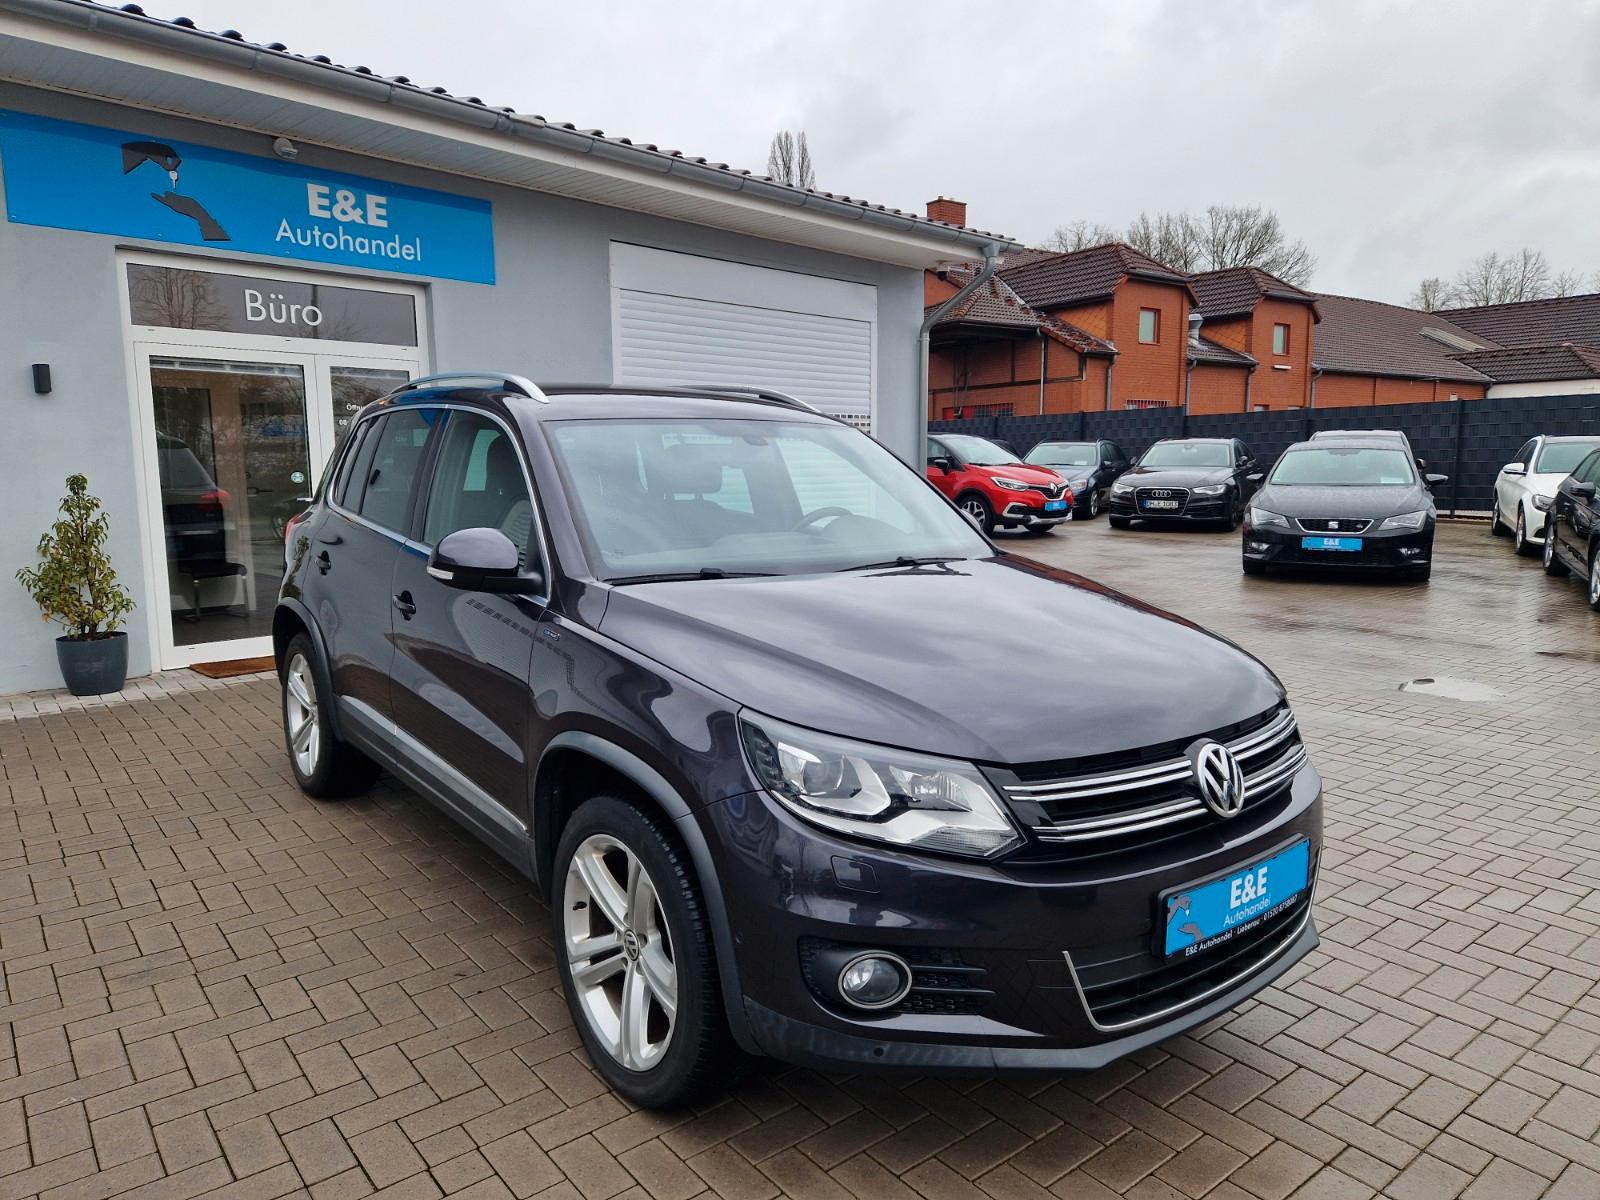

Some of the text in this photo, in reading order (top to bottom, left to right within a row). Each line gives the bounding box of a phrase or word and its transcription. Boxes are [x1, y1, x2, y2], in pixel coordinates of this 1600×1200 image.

[307, 183, 388, 228] E&E
[275, 217, 421, 261] Autohandel
[245, 289, 322, 326] Büro
[1230, 866, 1268, 909] E&E
[1223, 893, 1271, 927] Autohandel
[1185, 944, 1198, 956] E&E
[1199, 930, 1233, 951] Autohandel
